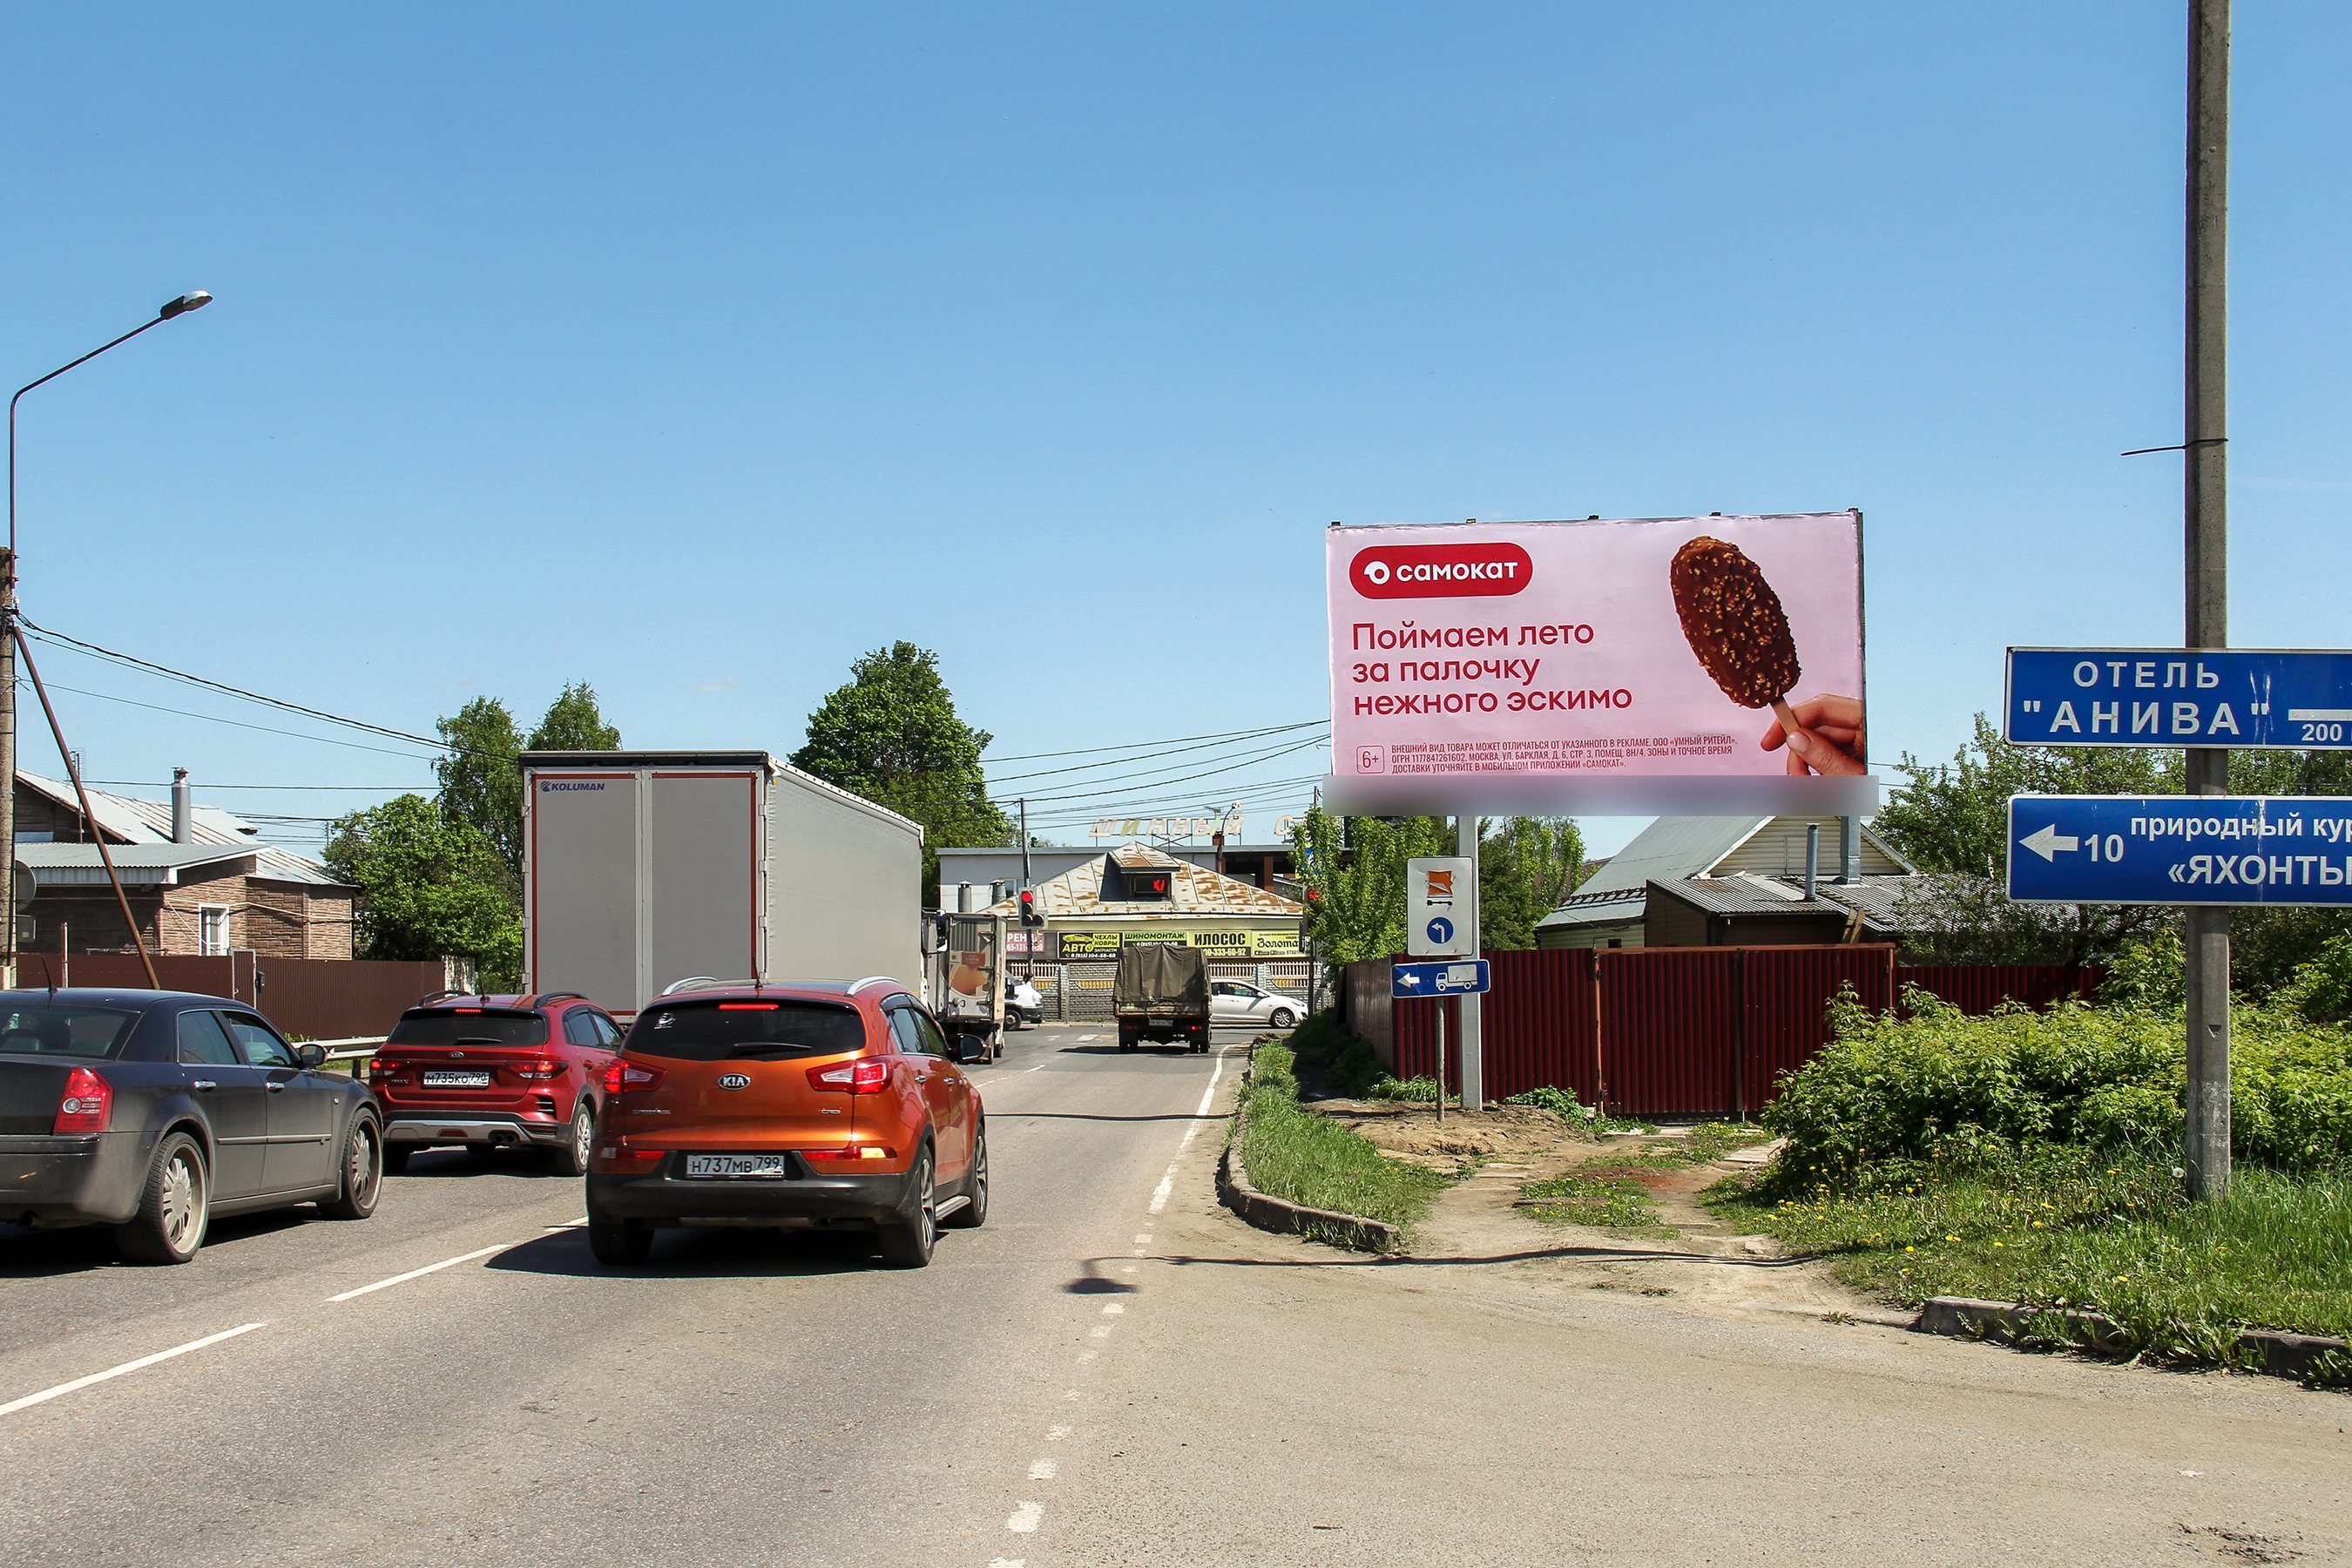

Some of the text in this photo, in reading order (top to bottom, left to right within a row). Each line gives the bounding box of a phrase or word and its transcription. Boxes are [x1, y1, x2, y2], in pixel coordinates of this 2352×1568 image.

[1396, 560, 1518, 582] самокат
[1352, 620, 1594, 650] Поймаем лето
[1352, 658, 1541, 686] за палочку
[2073, 661, 2220, 688] ОТЕЛЬ
[1354, 688, 1632, 716] нежного эскимо
[2023, 700, 2268, 735] "АНИВА"
[2301, 723, 2342, 742] 200
[1392, 743, 1427, 753] ВНЕШНИЙ
[1429, 744, 1444, 753] ВИД
[1447, 743, 1474, 752] ТОВАРА
[1476, 742, 1500, 751] МОЖЕТ
[1502, 740, 1549, 750] ОТЛИЧАТЬСЯ
[1551, 740, 1559, 749] ОТ
[1561, 739, 1608, 749] УКАЗАННОГО
[1610, 739, 1615, 747] В
[1617, 739, 1652, 747] РЕКЛАМЕ.
[1653, 737, 1668, 746] ООО
[1670, 735, 1702, 747] «УМНЫЙ
[1362, 751, 1379, 768] 6+
[1392, 754, 1409, 763] ОГРН
[1469, 753, 1500, 761] МОСКВА,
[1502, 752, 1514, 761] УЛ.
[1516, 751, 1551, 760] БАРКЛАЯ,
[1552, 751, 1559, 760] Д.
[1570, 750, 1585, 759] СТР.
[1595, 749, 1624, 758] ПОМЕЩ.
[1648, 747, 1669, 756] ЗОНЫ
[1671, 747, 1676, 756] И
[1678, 747, 1706, 756] ТОЧНОЕ
[1707, 746, 1733, 754] ВРЕМЯ
[1392, 760, 1626, 774] ДОСТАВКИ УТОЧНЯЙТЕ В МОБИЛЬНОМ ПРИЛОЖЕНИИ «САМОКАТ».
[551, 782, 605, 791] KOLUMAN
[1089, 812, 1244, 836] ШИННЫЙ
[2131, 812, 2302, 841] природный
[2085, 835, 2124, 862] 10
[1063, 944, 1094, 953] АВТО
[1194, 934, 1246, 945] ИЛОСОС
[426, 1072, 486, 1084] М735КО 790
[723, 1077, 746, 1086] KIA
[692, 1157, 780, 1173] Н737МВ 799
